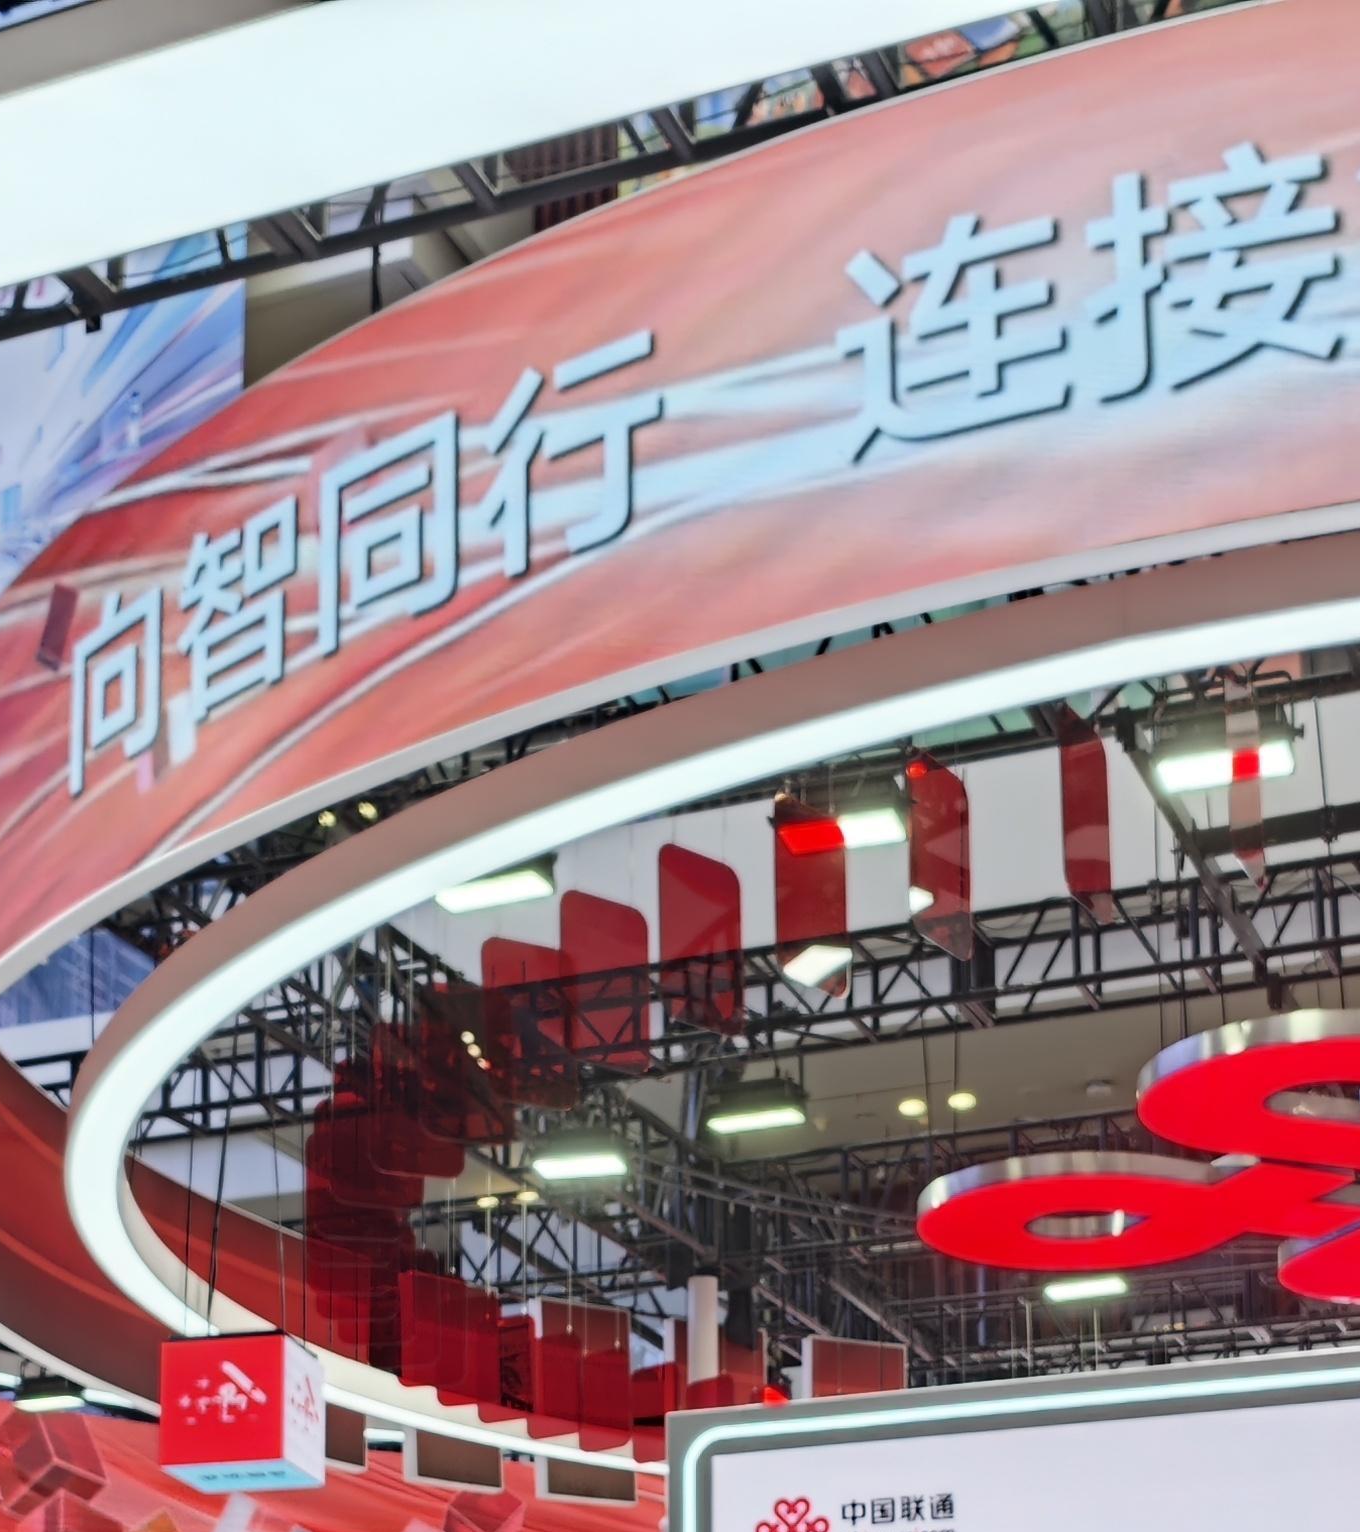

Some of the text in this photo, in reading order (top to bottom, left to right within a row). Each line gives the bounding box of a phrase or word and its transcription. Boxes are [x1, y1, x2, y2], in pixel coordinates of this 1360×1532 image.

[68, 330, 664, 798] 向智同行
[841, 1493, 955, 1526] 中国联通
